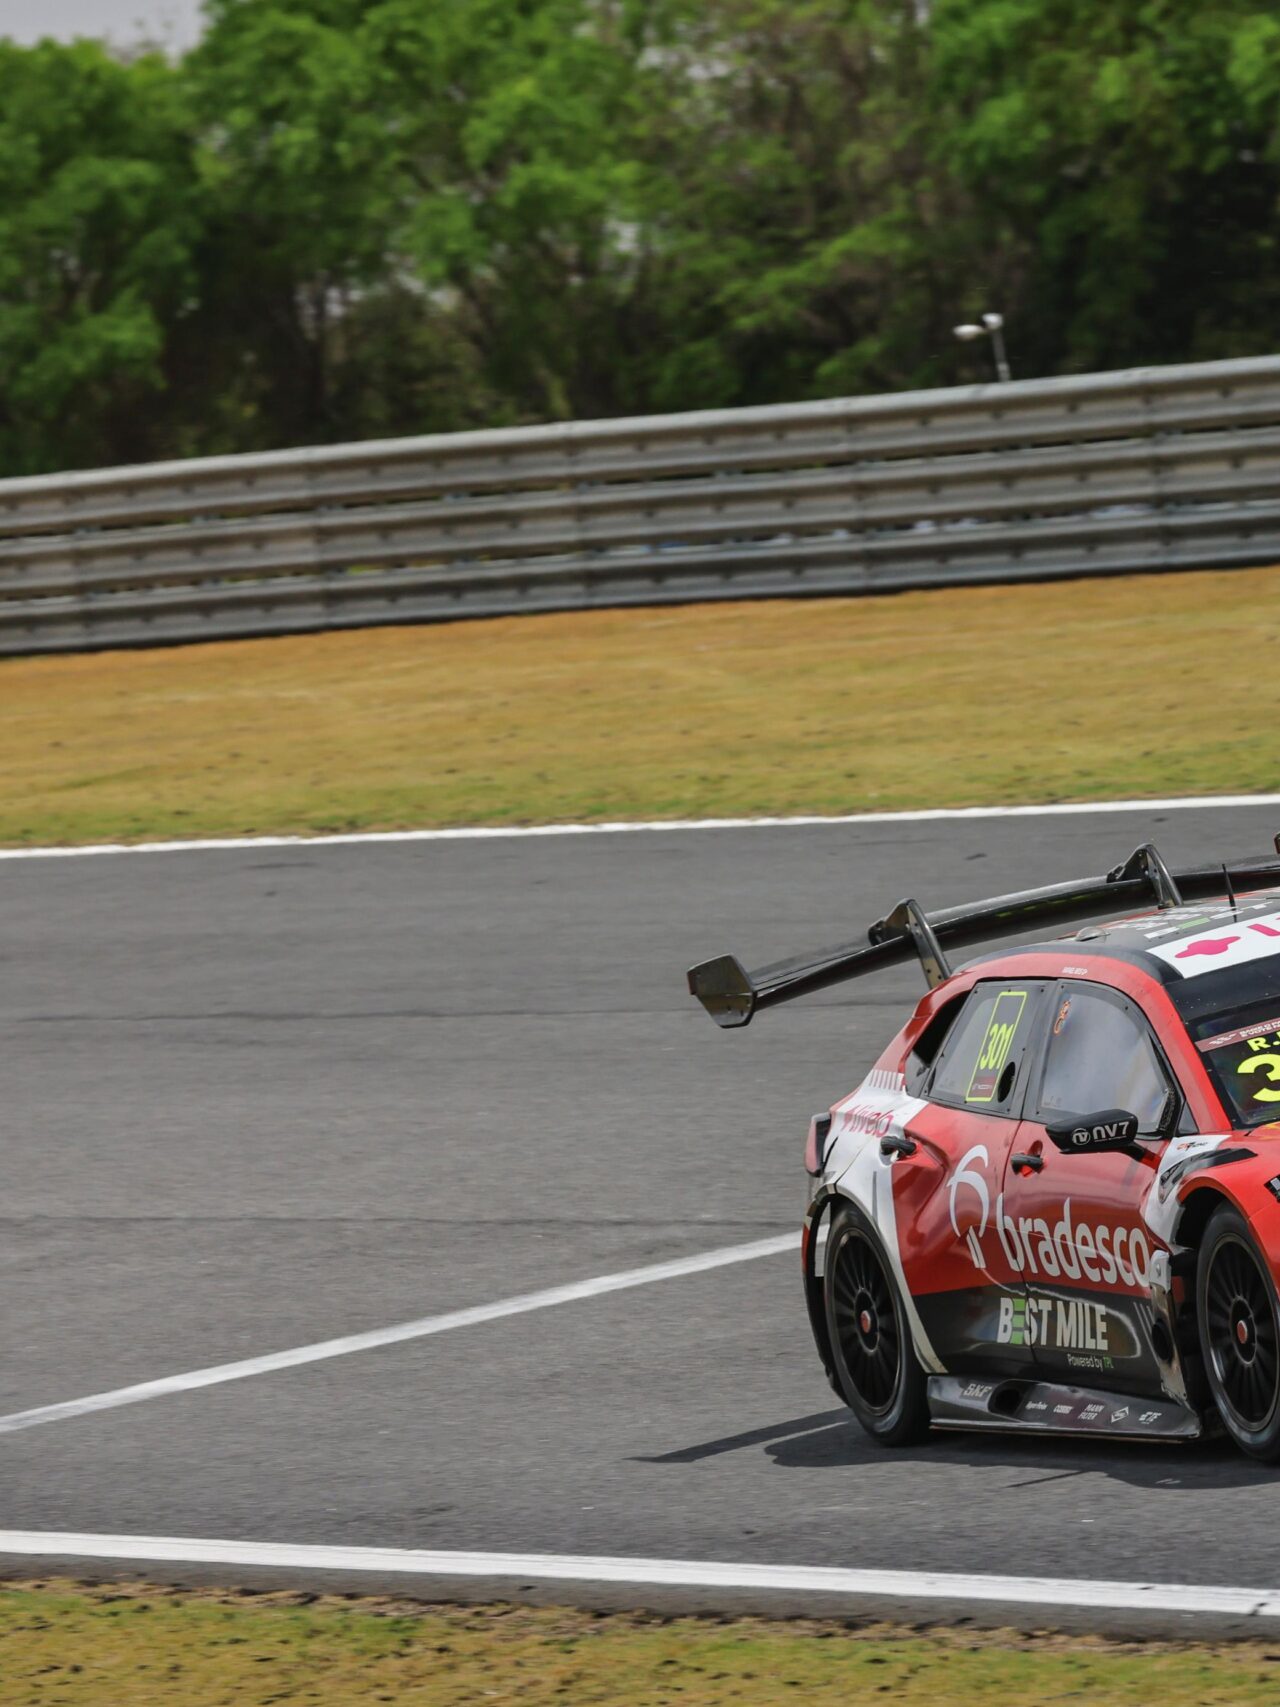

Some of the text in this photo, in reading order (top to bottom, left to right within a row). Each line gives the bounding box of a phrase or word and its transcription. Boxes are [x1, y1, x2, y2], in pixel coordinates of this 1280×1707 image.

[980, 1023, 1015, 1070] 301
[996, 1192, 1152, 1288] bradesco
[996, 1297, 1109, 1350] BEST MILE
[1067, 1353, 1093, 1368] Powered
[1093, 1356, 1103, 1373] by
